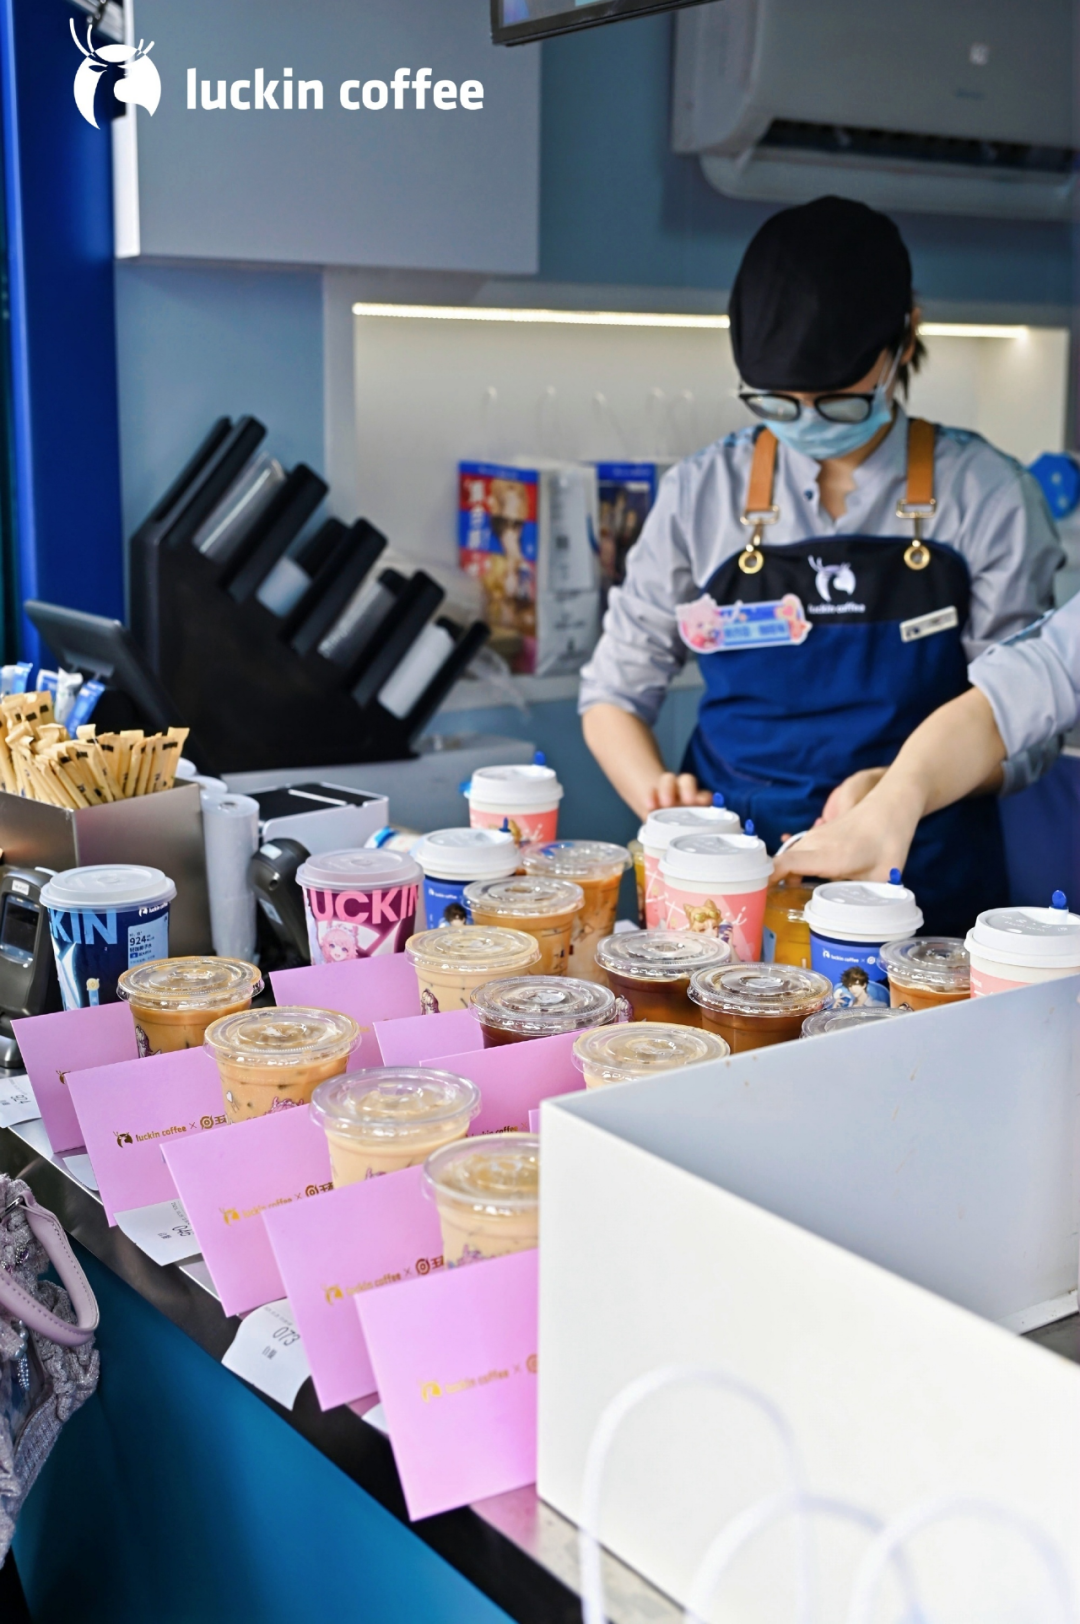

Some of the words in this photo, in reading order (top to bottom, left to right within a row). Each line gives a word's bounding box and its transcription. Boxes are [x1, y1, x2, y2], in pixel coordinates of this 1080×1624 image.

[836, 601, 866, 614] coffee
[129, 935, 146, 947] 924
[135, 1130, 160, 1143] luckin
[161, 1124, 187, 1137] coffee
[272, 1326, 301, 1347] 073
